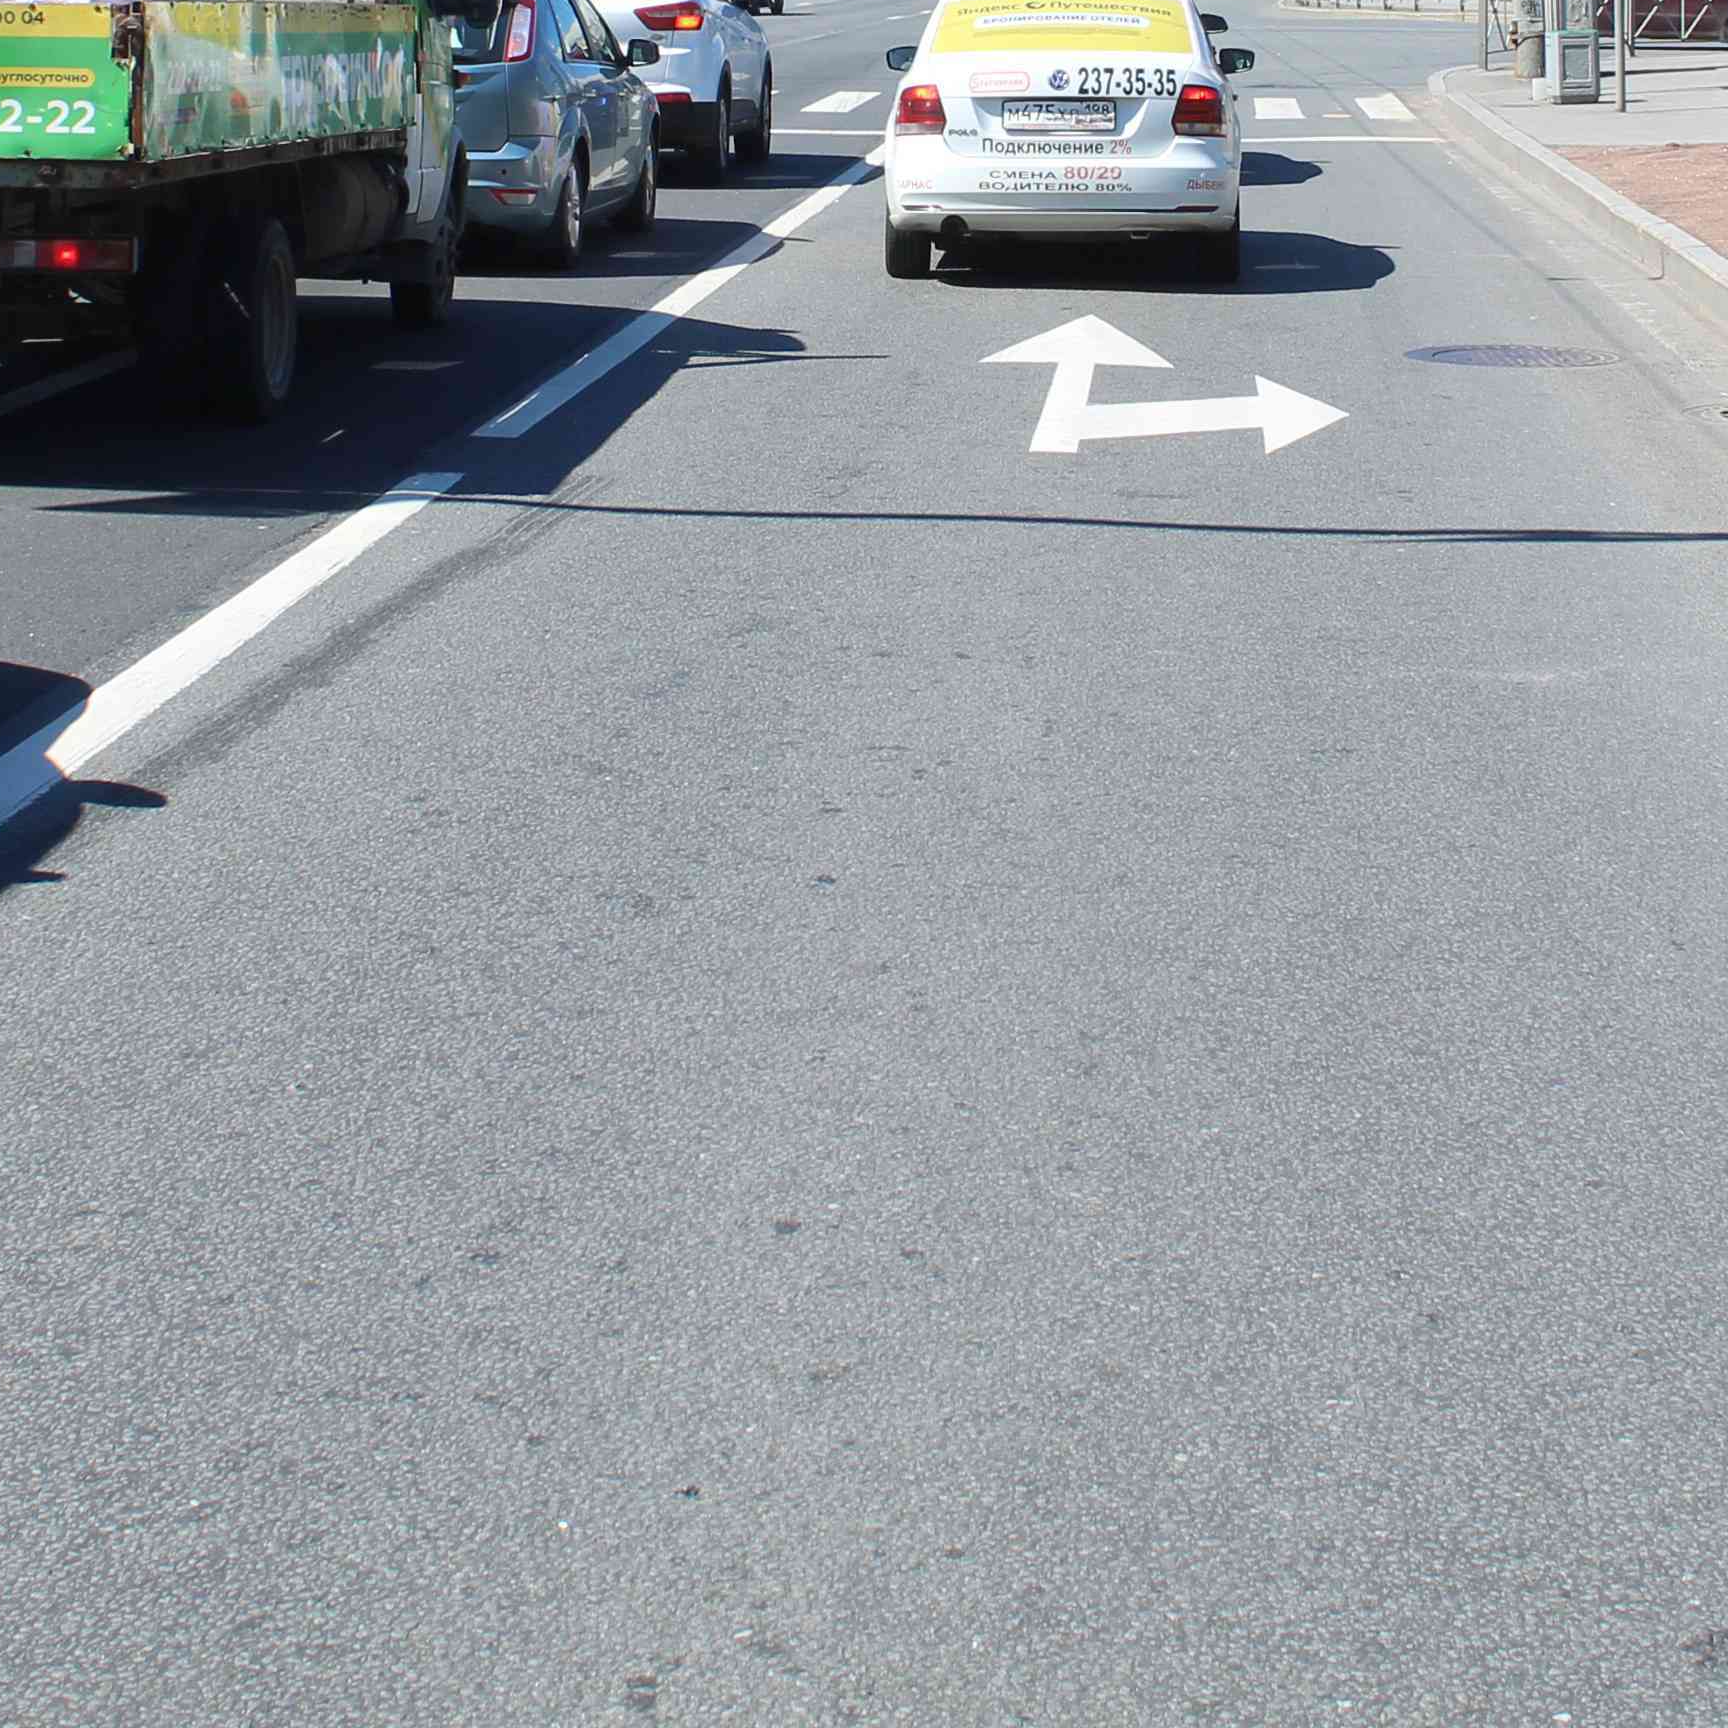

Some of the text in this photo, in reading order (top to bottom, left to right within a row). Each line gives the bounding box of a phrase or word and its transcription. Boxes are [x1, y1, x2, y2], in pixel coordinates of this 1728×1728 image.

[21, 10, 45, 25] 04
[1077, 67, 1177, 97] 237-35-35
[981, 137, 1133, 155] Подключение 2%
[988, 169, 1058, 180] СМЕНА
[978, 181, 1133, 192] ВОДИТЕЛЮ 80%
